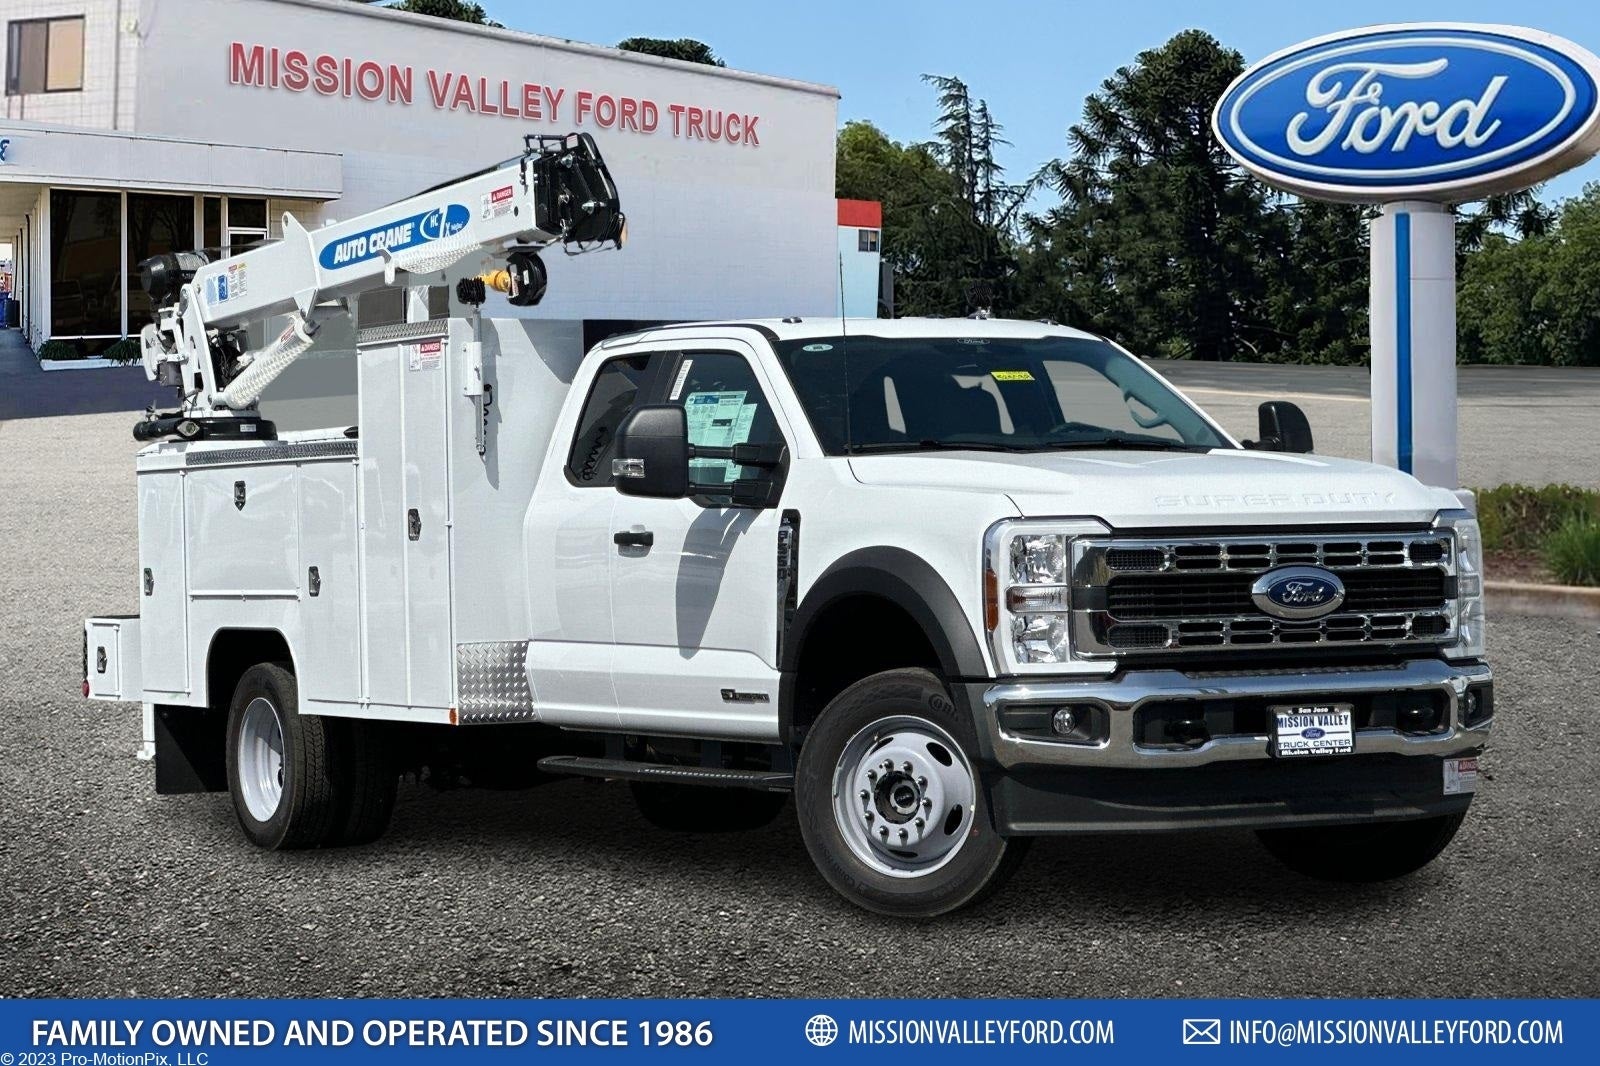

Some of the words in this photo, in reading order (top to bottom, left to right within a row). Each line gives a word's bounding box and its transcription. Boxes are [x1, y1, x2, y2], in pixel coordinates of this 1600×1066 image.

[229, 41, 414, 106] MISSION
[427, 69, 565, 122] VALLEY
[576, 90, 659, 135] FORD
[669, 103, 760, 146] TRUCK
[1286, 57, 1509, 157] Ford
[333, 238, 367, 265] AUTO
[369, 222, 413, 251] CRANE
[1154, 494, 1298, 508] SUPER
[1282, 581, 1325, 603] Ford
[1277, 715, 1315, 729] MISSION
[1317, 714, 1349, 727] VALLEY
[1305, 729, 1321, 739] Ford
[1278, 740, 1310, 749] TRUCK
[1312, 739, 1351, 748] CENTER
[1310, 747, 1334, 755] Valley
